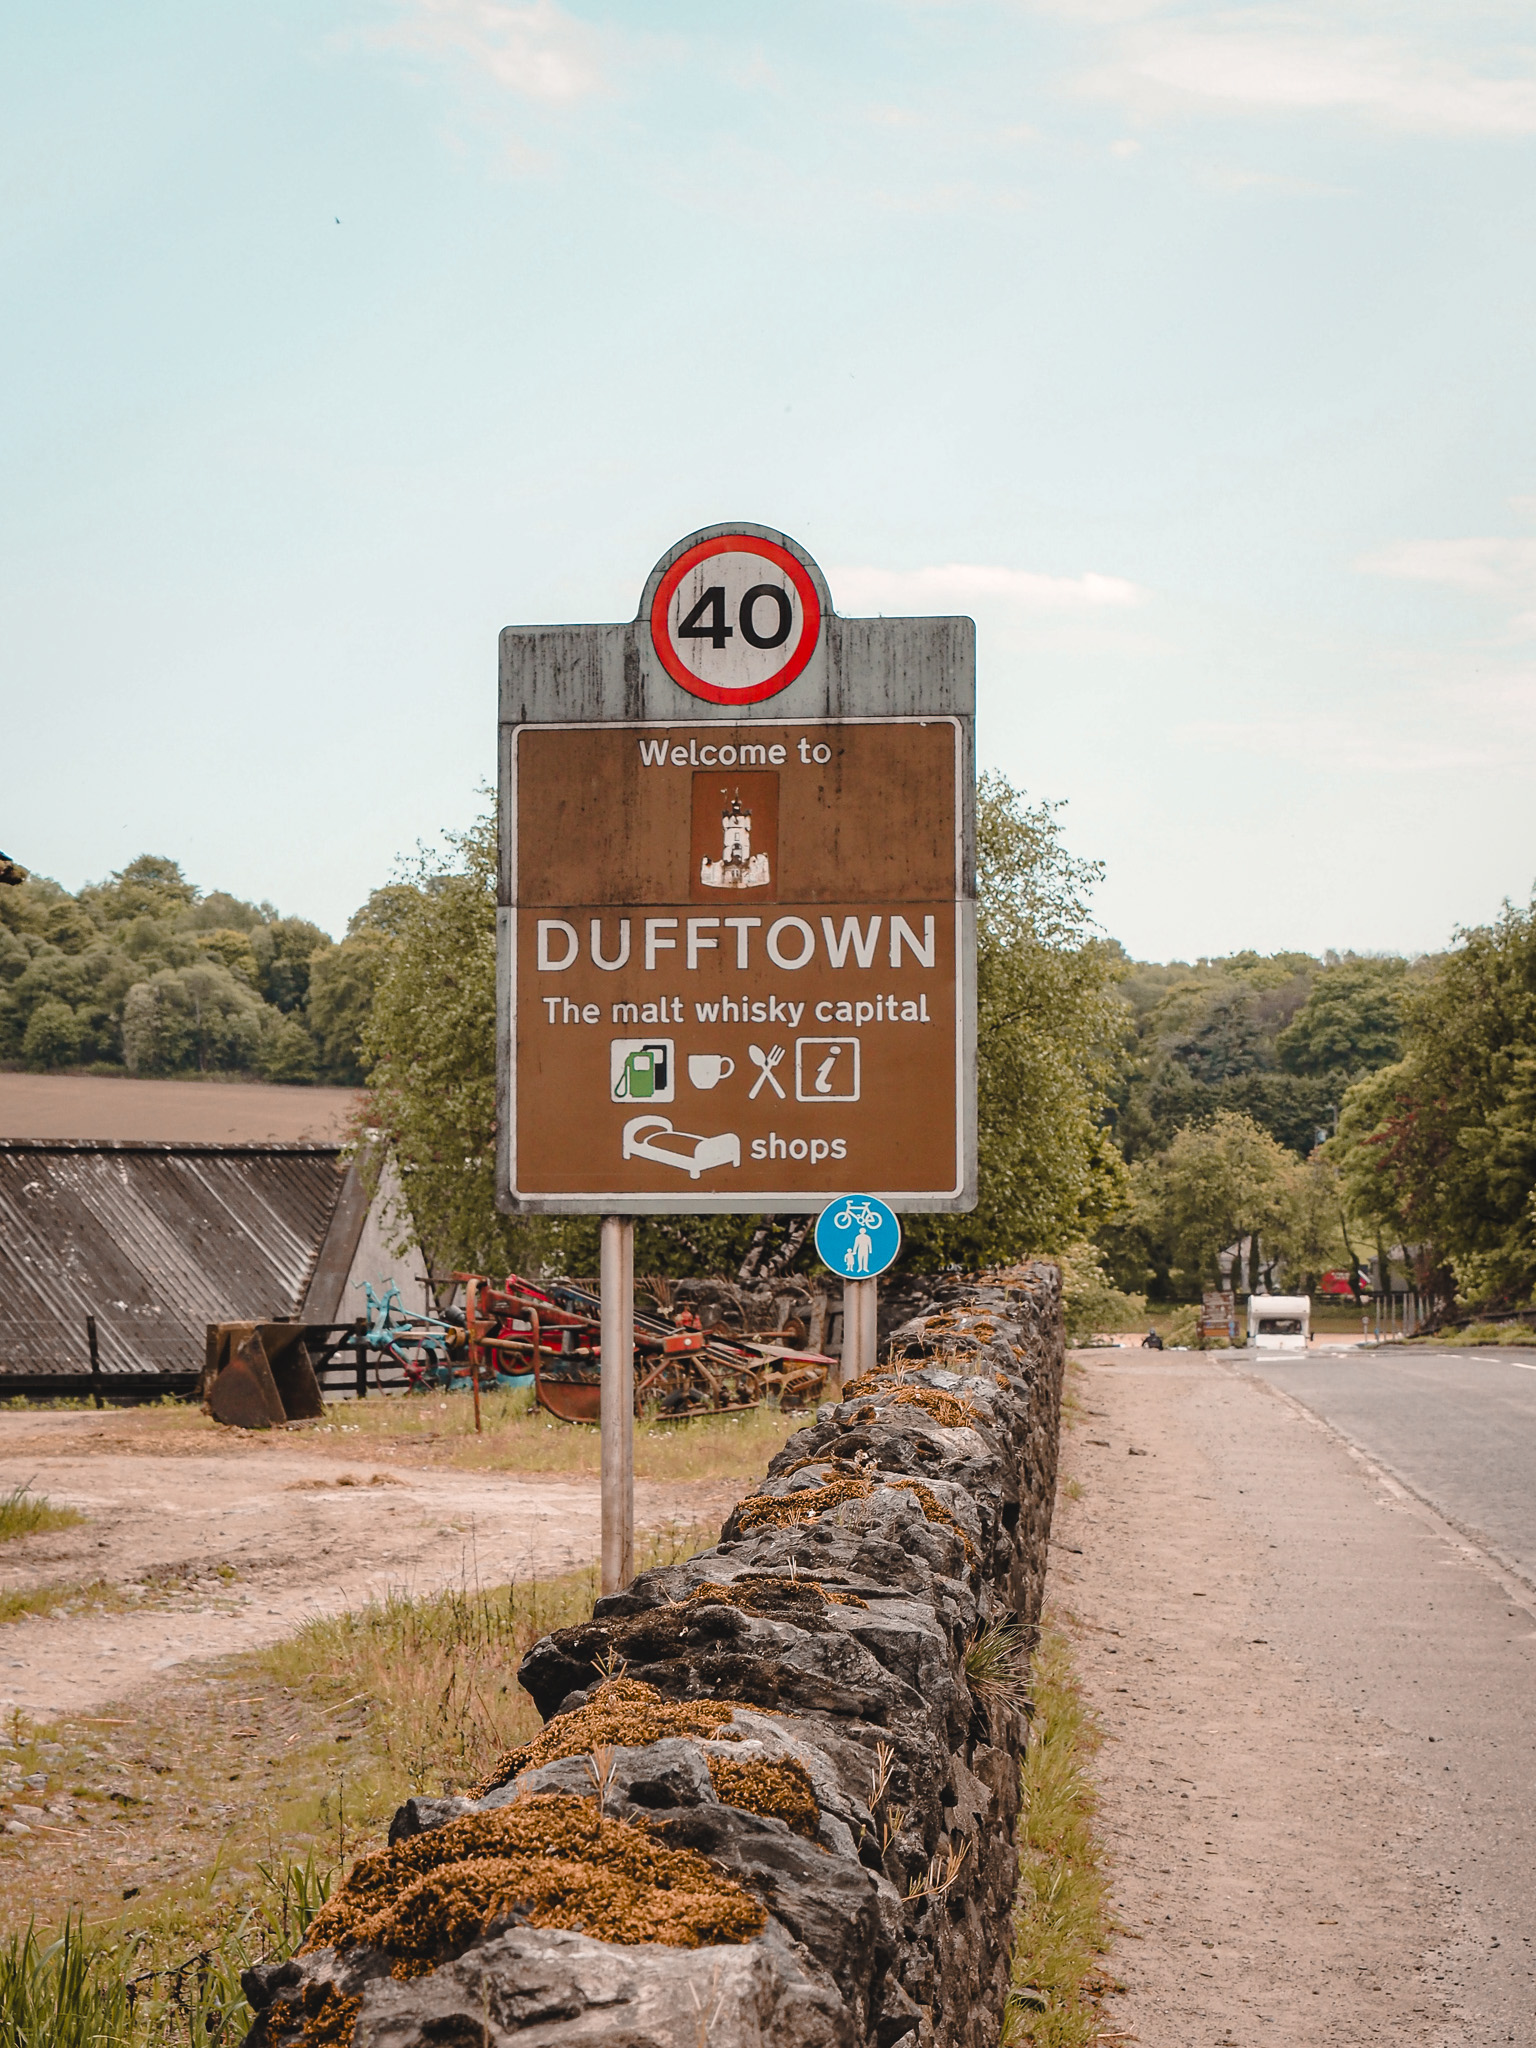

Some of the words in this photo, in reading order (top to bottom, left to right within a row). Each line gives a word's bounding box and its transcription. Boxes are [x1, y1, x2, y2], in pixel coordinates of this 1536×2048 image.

[677, 583, 793, 650] 40
[639, 739, 787, 767] Welcome
[797, 737, 832, 764] to
[537, 915, 935, 971] DUFFTOWN
[542, 997, 601, 1024] The
[612, 996, 684, 1023] malt
[695, 995, 805, 1028] whisky
[815, 993, 931, 1027] capital
[750, 1132, 847, 1165] shops
